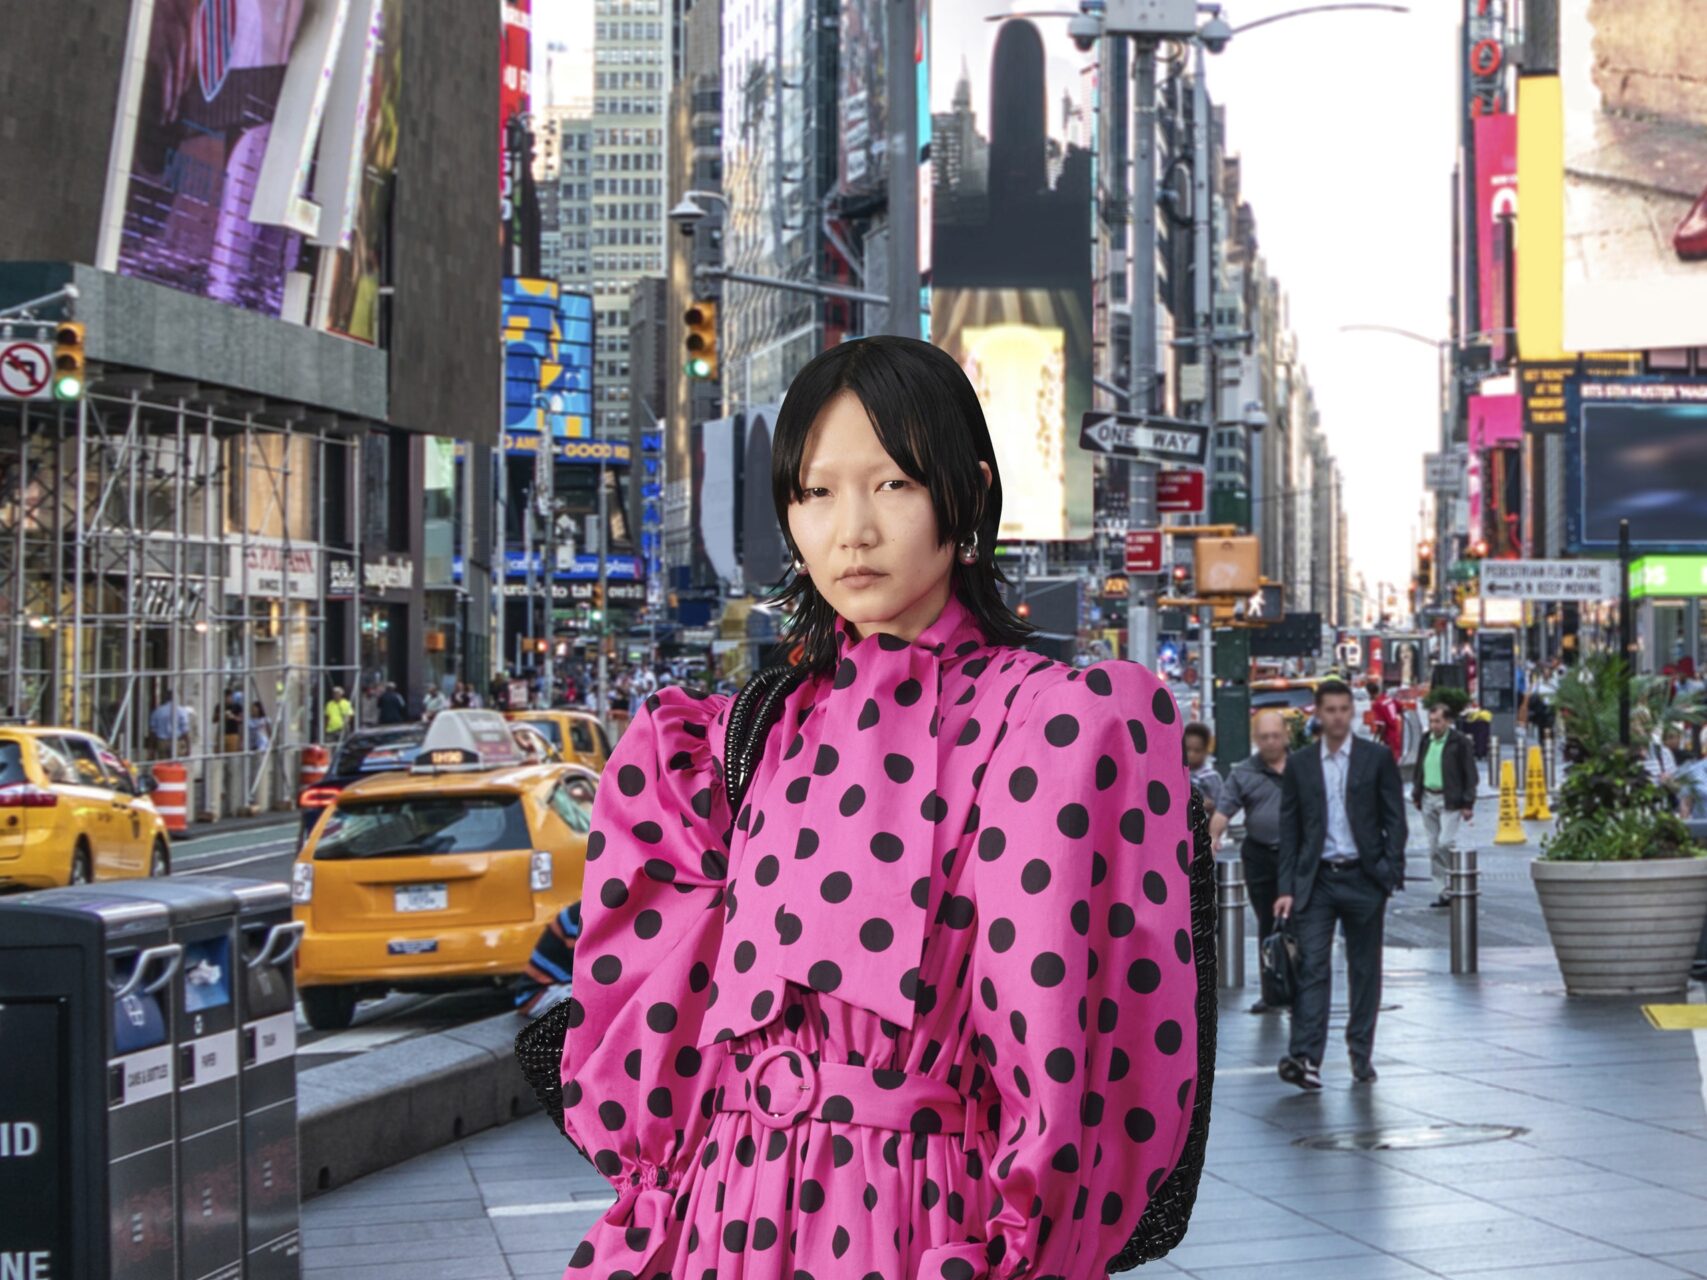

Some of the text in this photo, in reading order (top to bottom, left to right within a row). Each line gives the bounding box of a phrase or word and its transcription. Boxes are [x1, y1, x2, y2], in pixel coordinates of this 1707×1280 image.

[1097, 425, 1193, 449] ONE WAY
[565, 443, 612, 458] GOOD
[1486, 565, 1601, 578] PEDESTRIAN FLOW ZONE
[552, 585, 568, 598] to
[572, 584, 592, 598] tal
[1537, 582, 1602, 595] KEEP MOVING
[0, 1122, 39, 1157] ID
